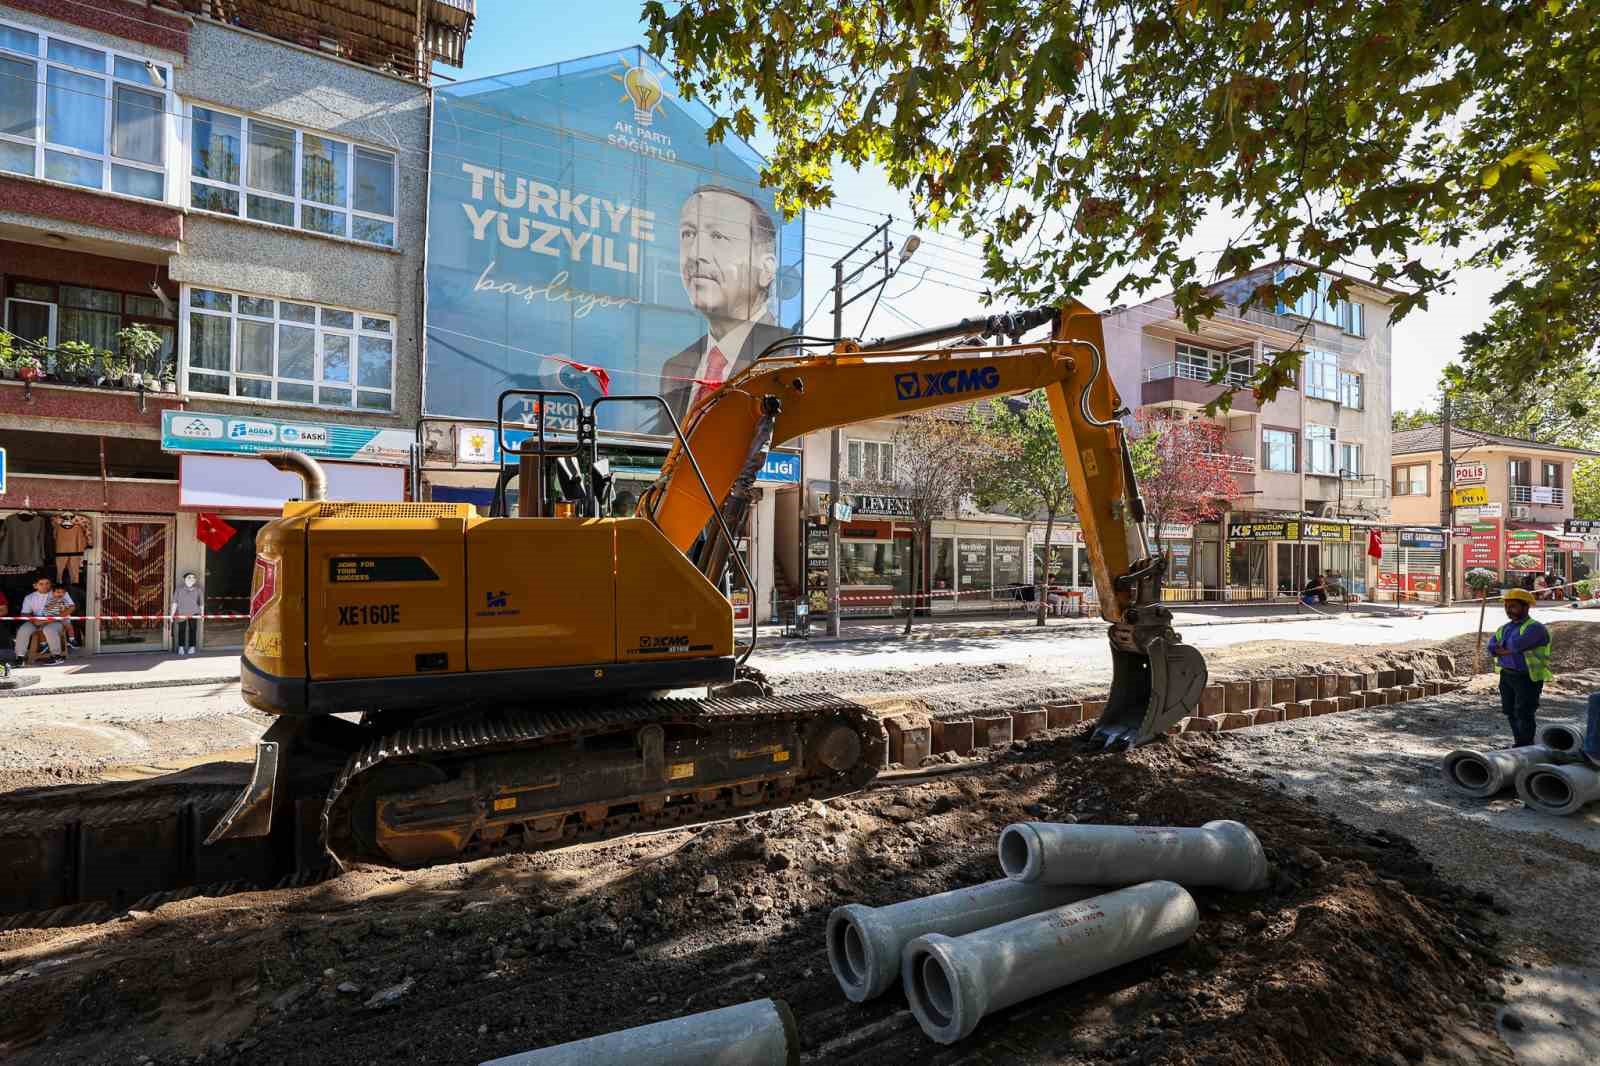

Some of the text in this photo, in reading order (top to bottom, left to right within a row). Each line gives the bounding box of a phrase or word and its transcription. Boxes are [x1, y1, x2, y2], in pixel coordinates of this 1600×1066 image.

[461, 162, 656, 242] TÜRKİYE
[461, 202, 640, 274] YÜZYILI
[925, 366, 1001, 398] XCMG
[301, 429, 326, 440] SASKİ
[1456, 466, 1483, 478] POLİS
[338, 604, 400, 626] XE160E
